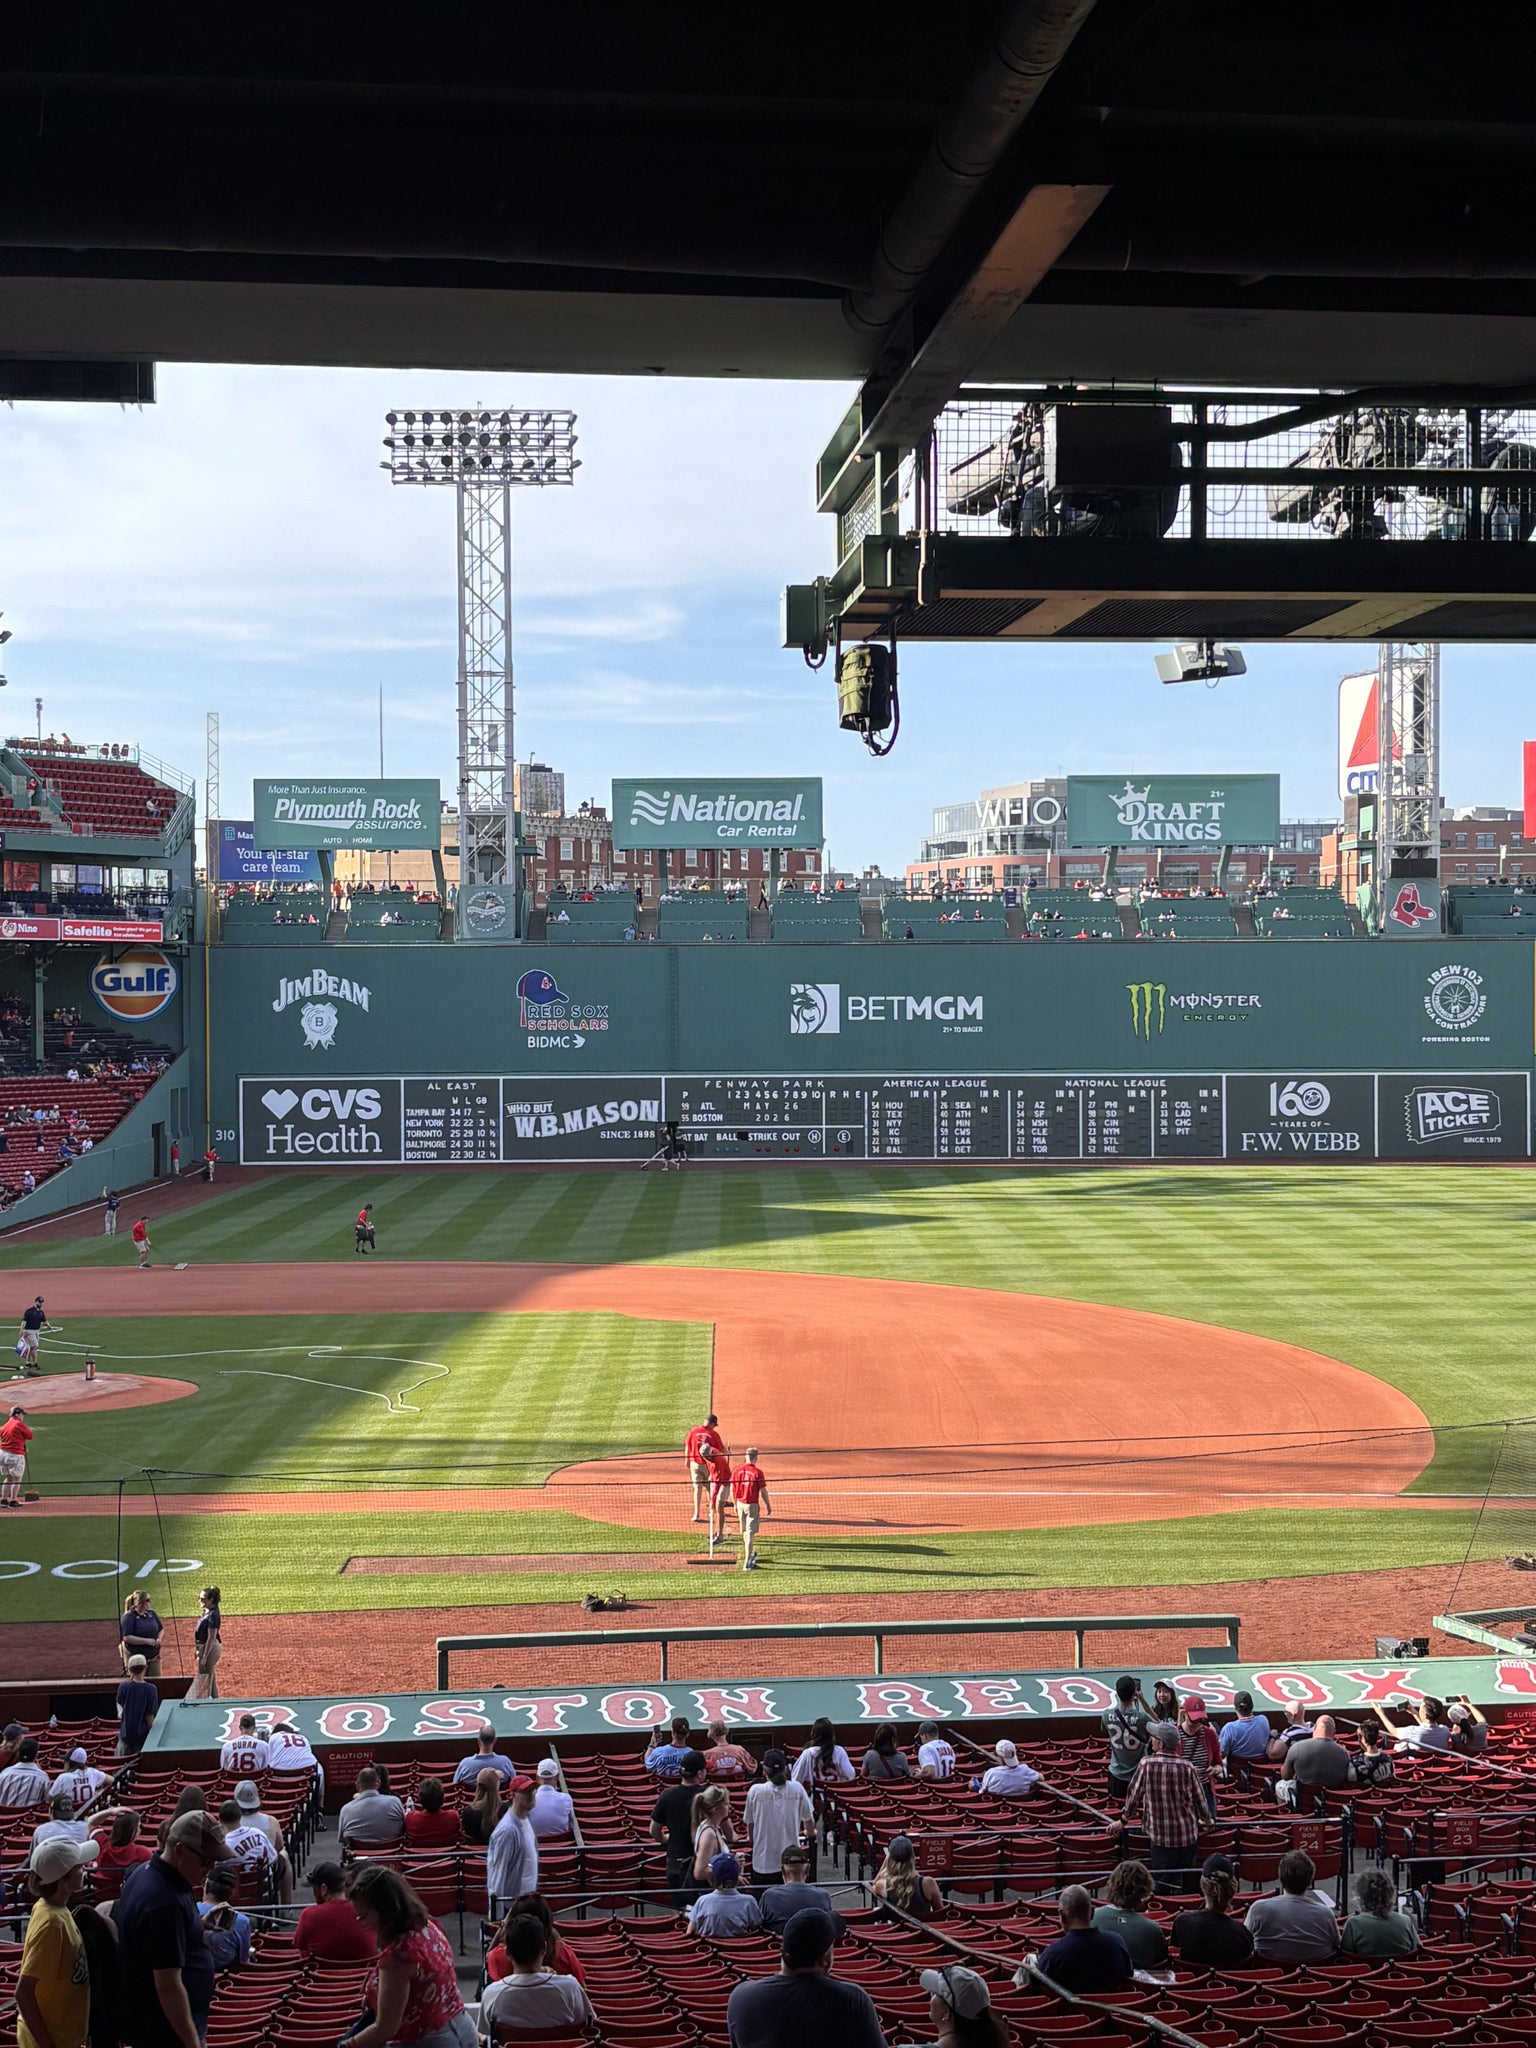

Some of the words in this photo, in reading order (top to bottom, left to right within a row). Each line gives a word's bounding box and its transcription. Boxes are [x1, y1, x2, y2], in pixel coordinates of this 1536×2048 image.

[268, 785, 289, 794] More
[290, 785, 310, 794] Than
[311, 785, 326, 794] Just
[328, 786, 366, 794] Insurance.
[274, 798, 366, 822] Plymouth
[371, 798, 421, 818] Rock
[1117, 804, 1225, 826] DRAFT
[717, 825, 743, 837] Car
[748, 825, 797, 836] Rental
[1130, 822, 1222, 841] KINGS
[242, 863, 268, 872] care
[64, 926, 112, 936] Safelite
[96, 968, 170, 992] Gulf
[1427, 965, 1461, 986] IBEW
[1462, 968, 1484, 986] 103
[848, 996, 983, 1020] BETMGM
[1170, 993, 1262, 1009] MONSTER
[528, 1005, 565, 1018] RED
[571, 1005, 608, 1018] SOX
[1435, 995, 1487, 1030] CONTRACTORS
[528, 1020, 608, 1030] SCHOLARS
[528, 1036, 570, 1048] BIDMC
[302, 1088, 382, 1120] CVS
[1270, 1081, 1331, 1117] 160
[1424, 1091, 1490, 1116] ACE
[506, 1104, 530, 1114] WHO
[533, 1103, 552, 1114] BUT
[1425, 1112, 1490, 1131] TICKET
[216, 1130, 236, 1141] 310
[266, 1124, 383, 1154] Health
[600, 1131, 631, 1139] SINCE
[634, 1130, 656, 1138] 1898
[694, 1133, 708, 1141] BAT
[716, 1133, 738, 1141] BALL
[748, 1133, 778, 1141] STRIKE
[782, 1133, 801, 1141] OUT
[1240, 1133, 1283, 1152] F.W.
[1288, 1133, 1360, 1151] WEBB
[215, 1686, 783, 1742] BOSTON
[856, 1676, 1119, 1719] RED
[1170, 1668, 1442, 1708] SOX
[282, 1734, 306, 1748] 16
[1107, 1724, 1140, 1750] 26
[232, 1741, 257, 1751] DURAN
[329, 1752, 373, 1761] CAUTION!
[72, 1785, 92, 1803] 10
[234, 1834, 263, 1856] ORTIZ
[1300, 1841, 1318, 1851] 24
[1452, 1835, 1472, 1845] 23
[927, 1855, 946, 1866] 25
